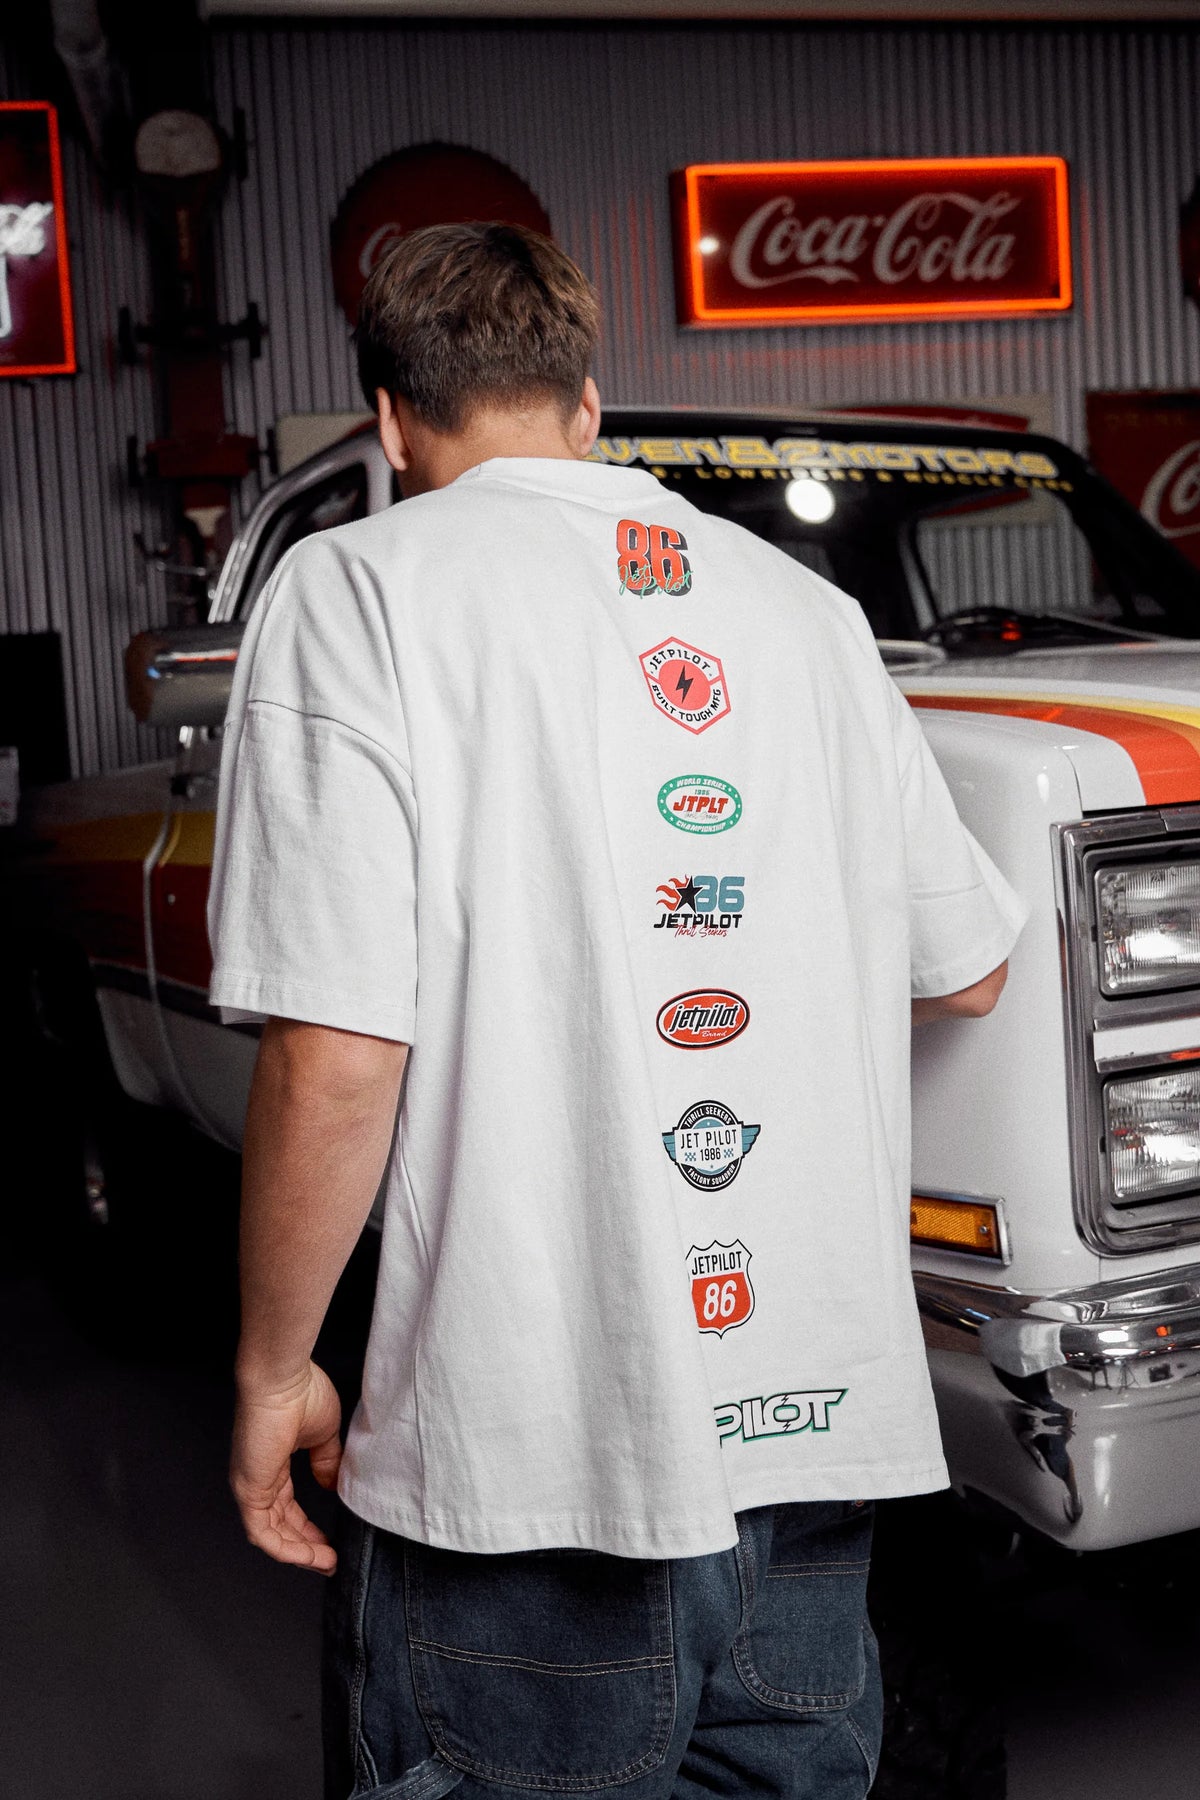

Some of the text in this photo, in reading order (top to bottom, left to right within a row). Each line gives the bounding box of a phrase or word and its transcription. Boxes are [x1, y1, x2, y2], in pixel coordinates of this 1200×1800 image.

[730, 191, 1022, 289] Coca-Cola
[616, 519, 690, 596] 86
[649, 648, 711, 671] JETPILOT
[651, 684, 722, 722] BUILT TOUGH MFG
[673, 795, 729, 814] JTPLT
[653, 913, 742, 928] JETPILOT
[668, 1003, 739, 1033] jetpilot
[684, 1106, 732, 1128] THRILL SEEKERS
[680, 1129, 737, 1149] JET PILOT
[699, 1147, 722, 1162] 1986
[687, 1163, 736, 1185] FACTORY SQUADRON
[691, 1250, 742, 1276] JETPILOT
[703, 1279, 737, 1321] 86
